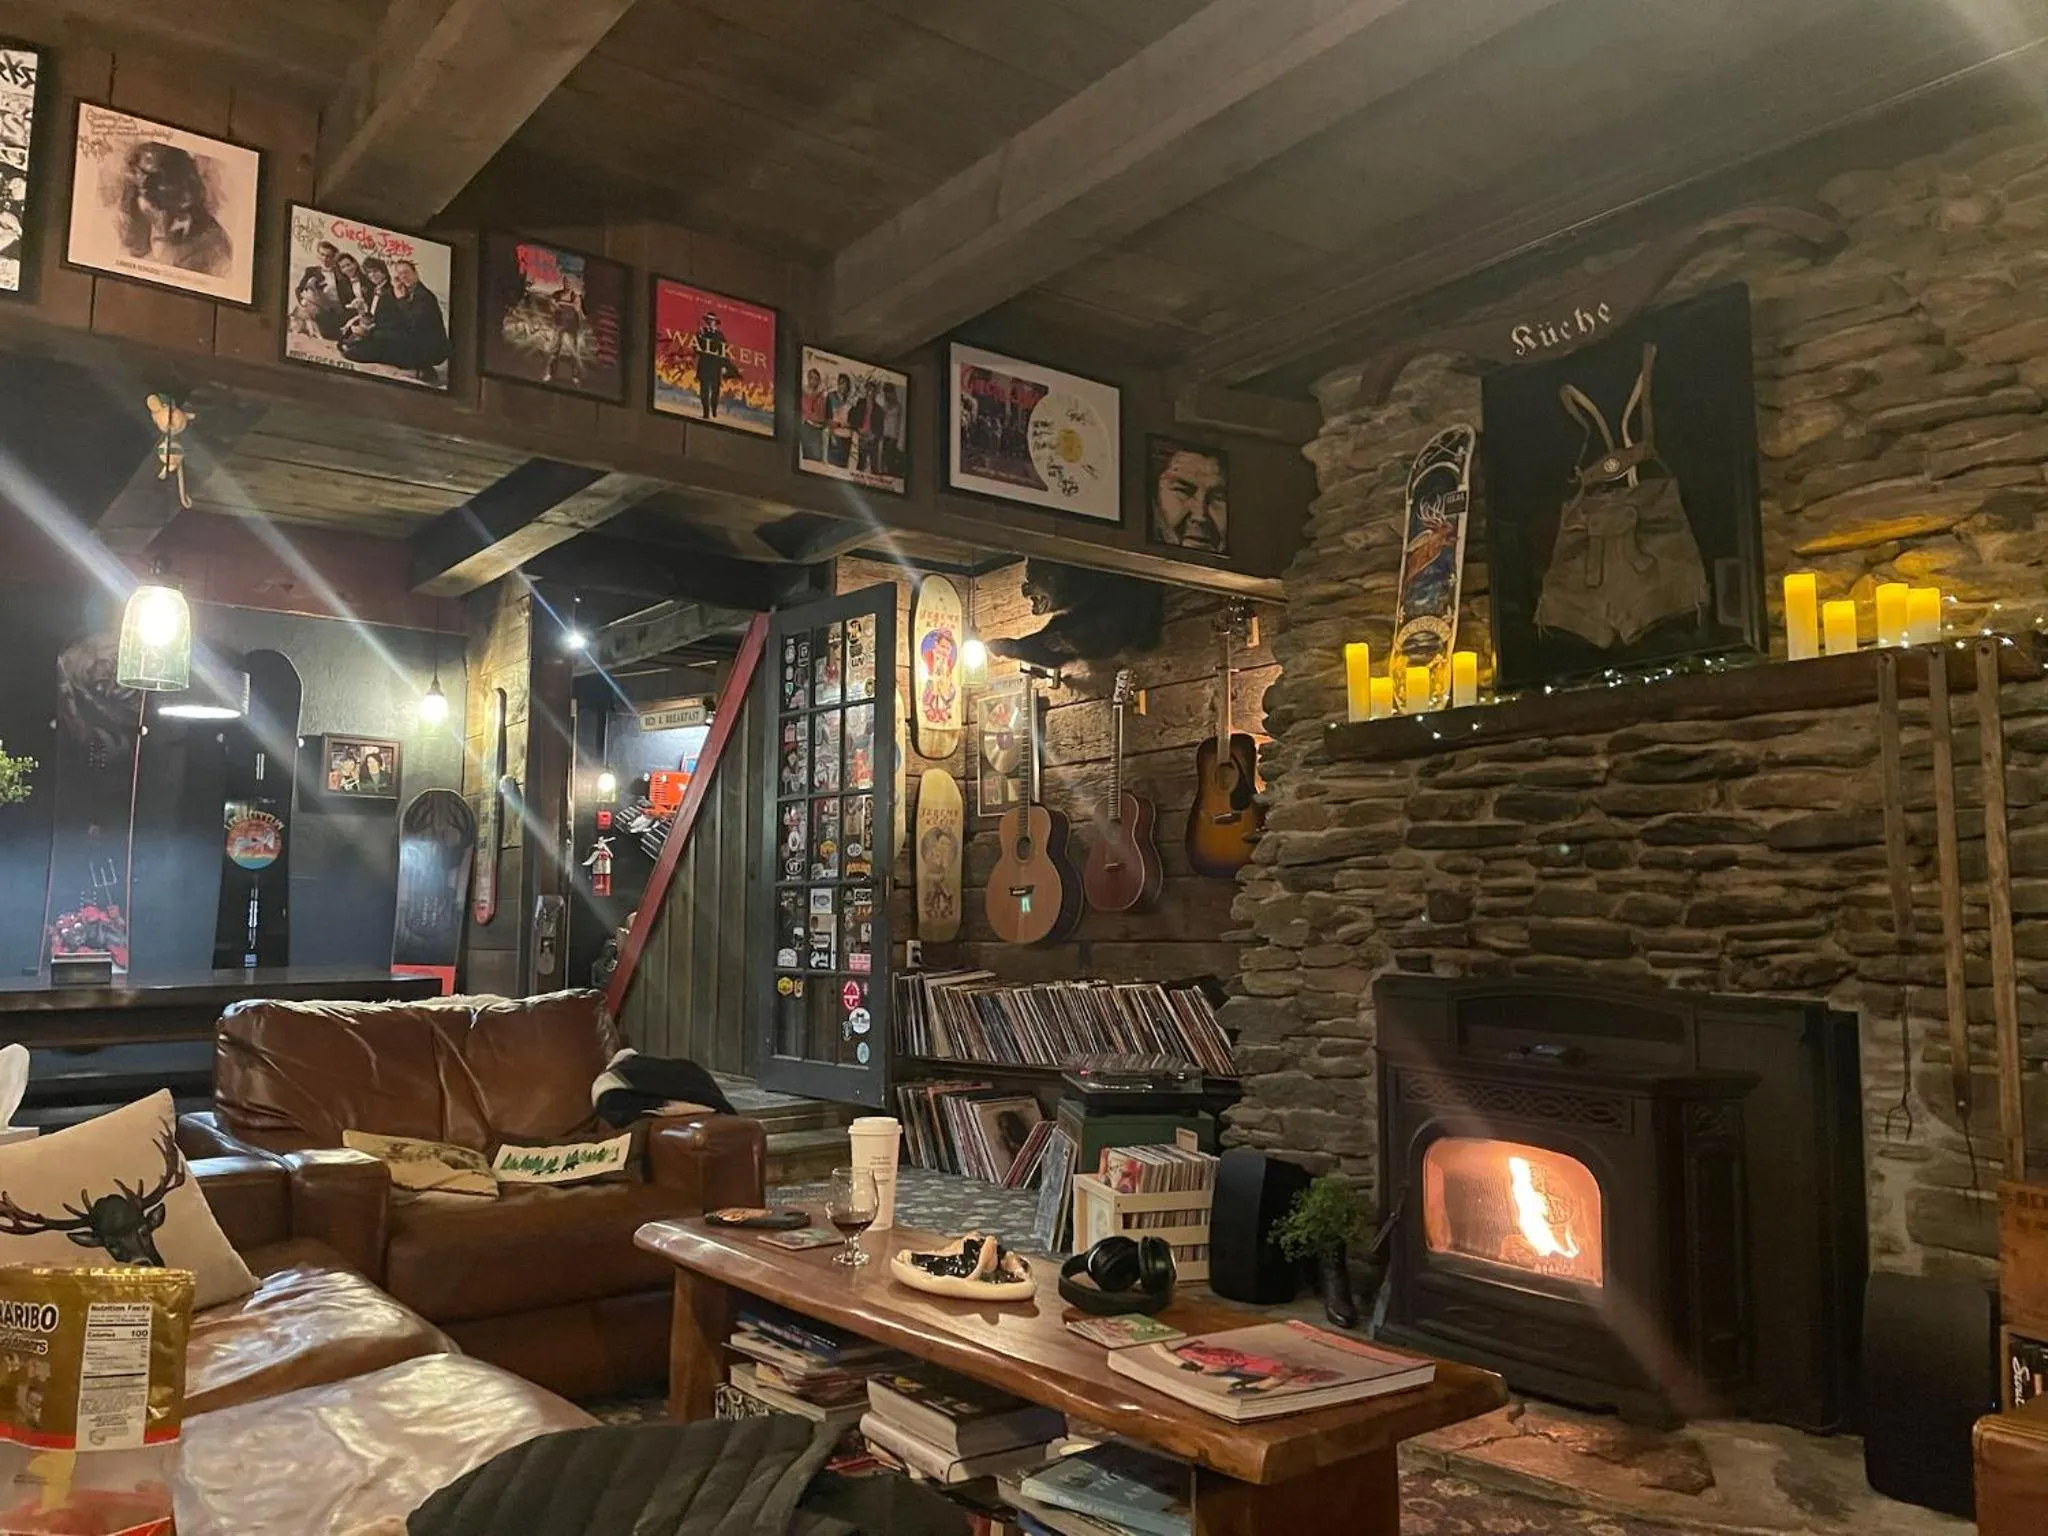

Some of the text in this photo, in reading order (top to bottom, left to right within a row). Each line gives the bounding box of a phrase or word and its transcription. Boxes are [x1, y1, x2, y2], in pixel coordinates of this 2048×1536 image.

[665, 328, 768, 369] WALKER
[1511, 302, 1612, 355] Küche
[131, 1329, 148, 1338] 100
